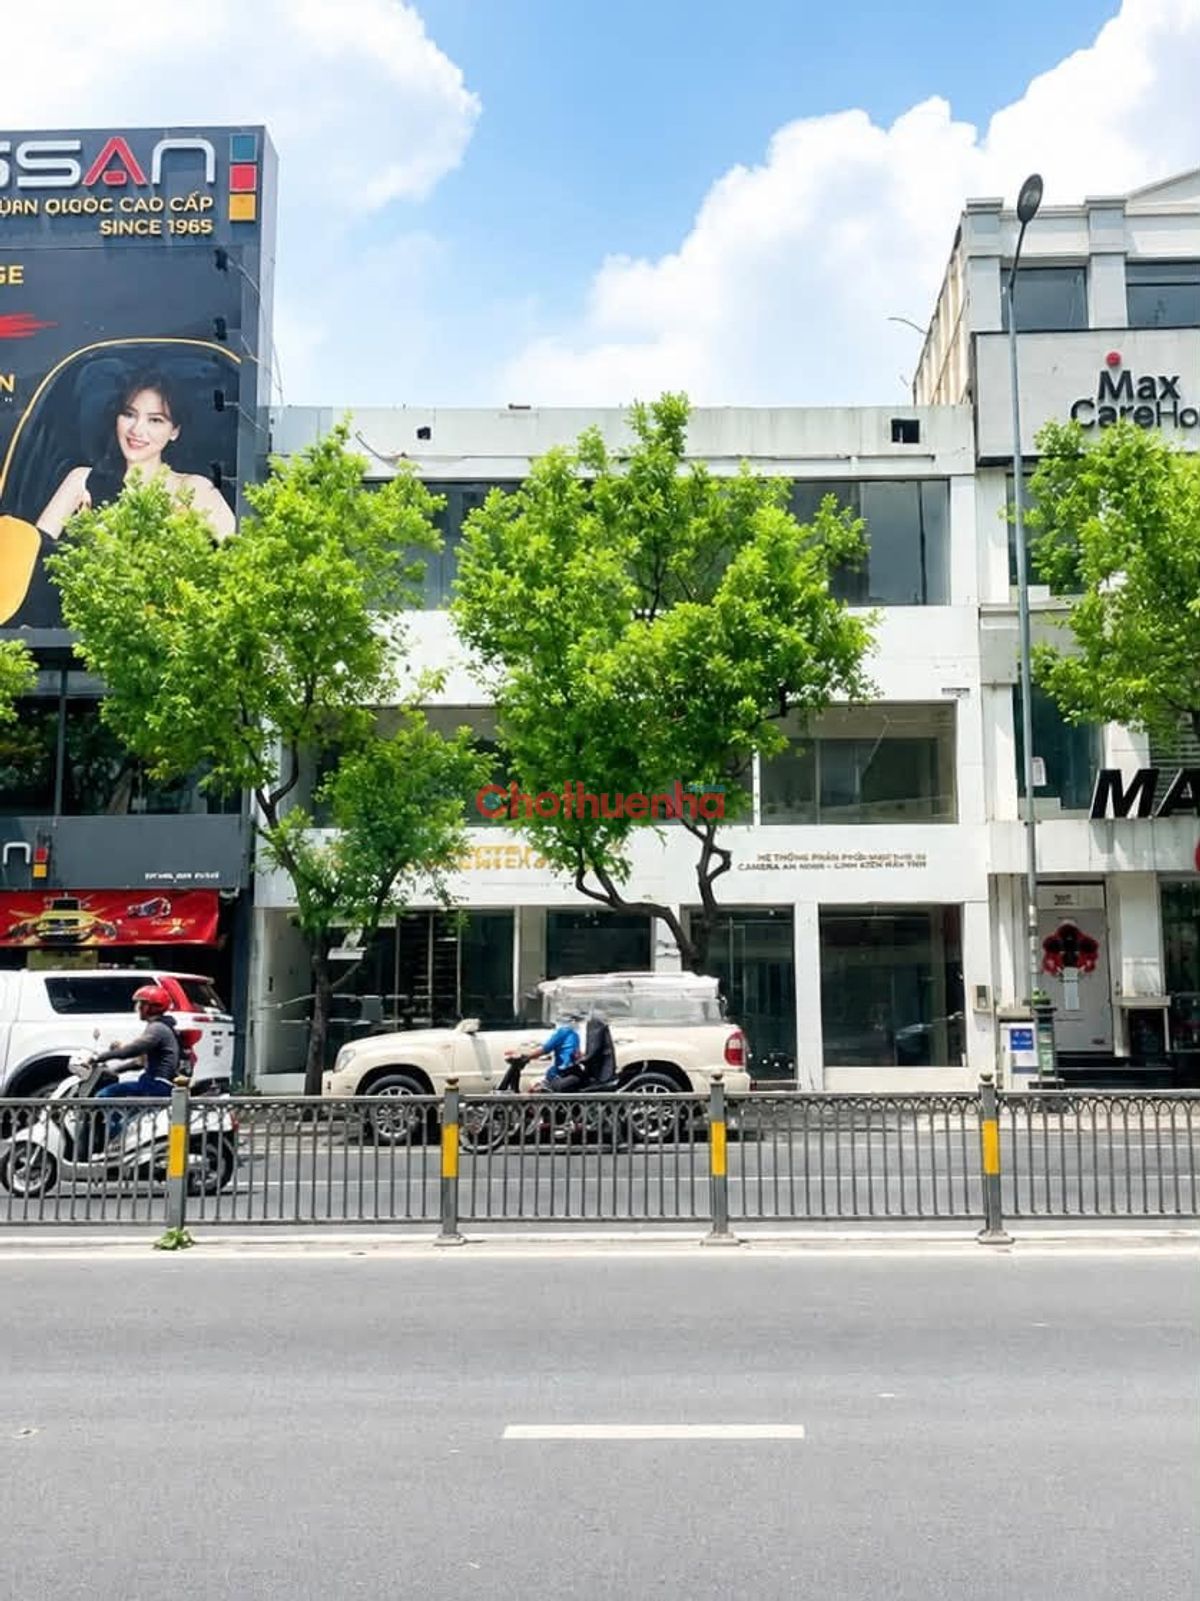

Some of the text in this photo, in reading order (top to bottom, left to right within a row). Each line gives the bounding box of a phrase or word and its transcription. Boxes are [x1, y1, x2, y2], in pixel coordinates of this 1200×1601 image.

[119, 197, 164, 213] CAO
[99, 219, 213, 235] SINCE 1965
[1098, 370, 1181, 400] Max
